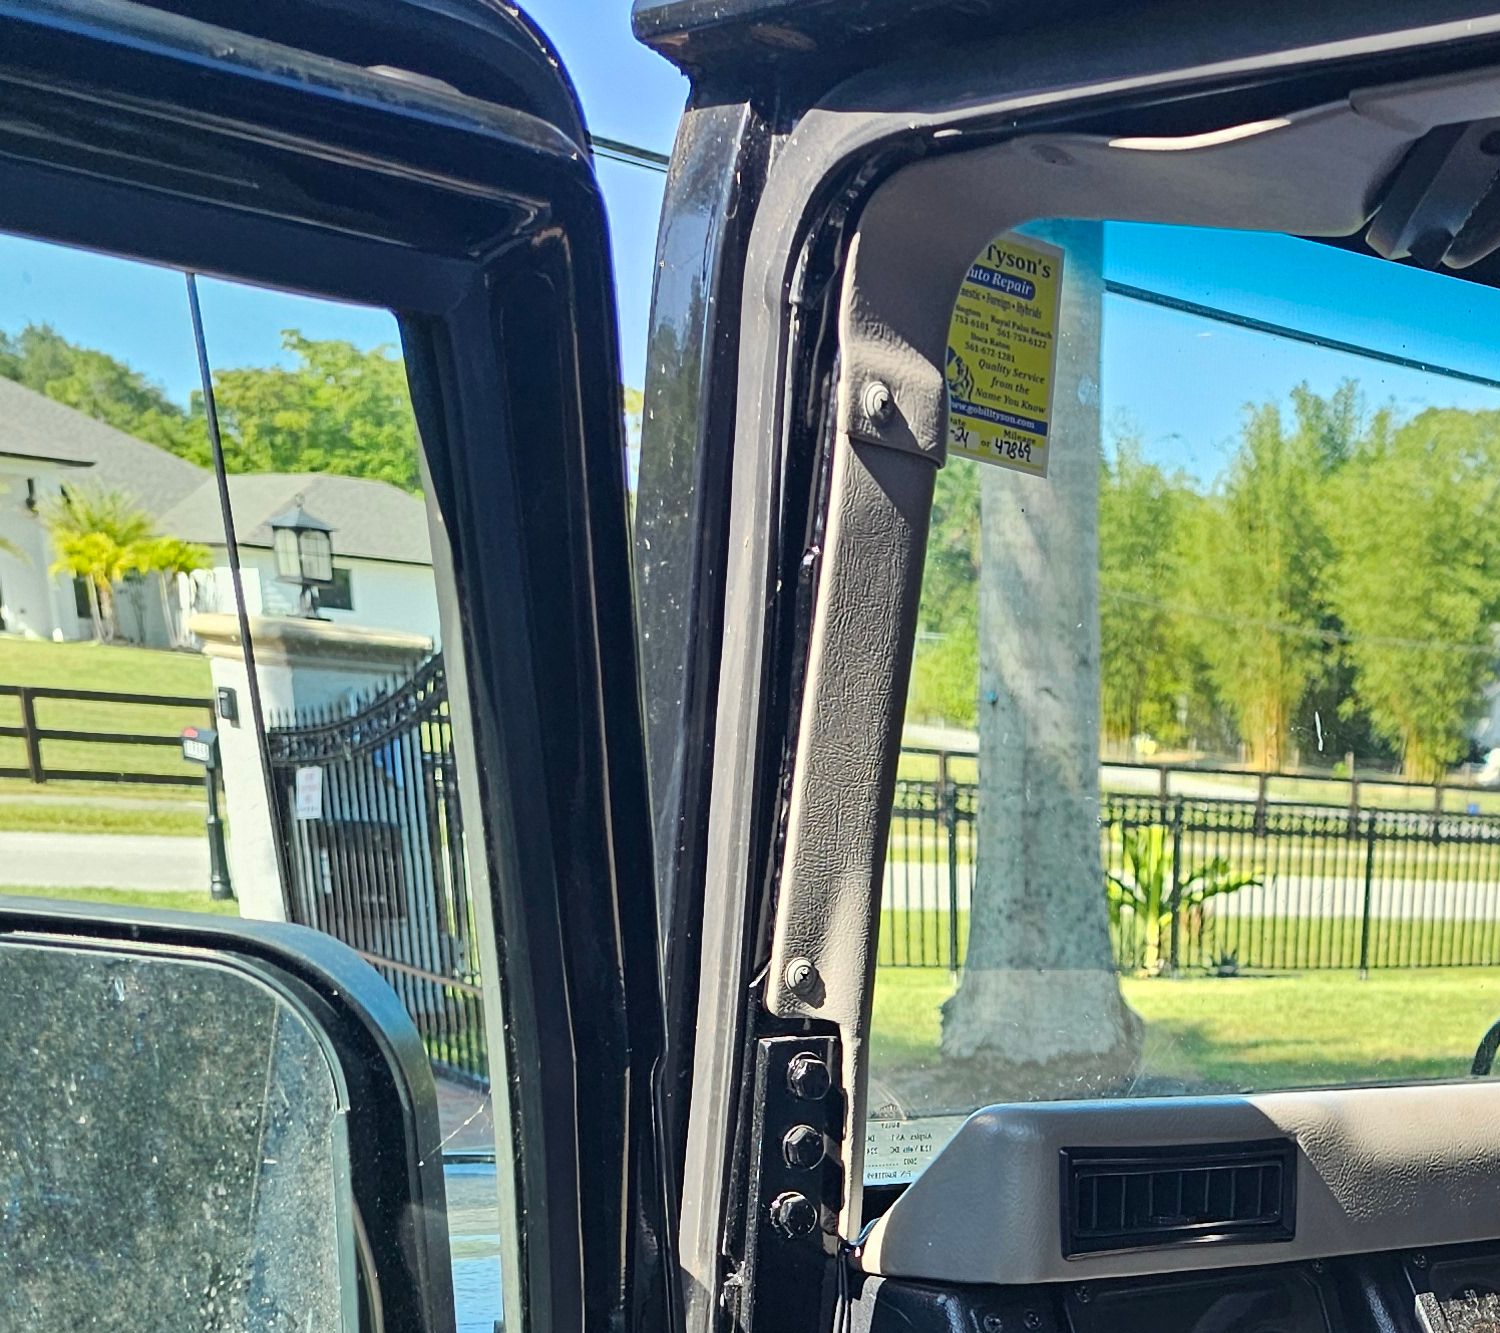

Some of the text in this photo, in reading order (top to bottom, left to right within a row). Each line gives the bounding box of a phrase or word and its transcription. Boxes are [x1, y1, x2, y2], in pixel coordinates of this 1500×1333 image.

[967, 265, 990, 282] uto
[991, 271, 1033, 297] Repair
[977, 357, 1045, 385] Quality Service
[990, 375, 1030, 396] from the
[975, 387, 1046, 414] Name You Know
